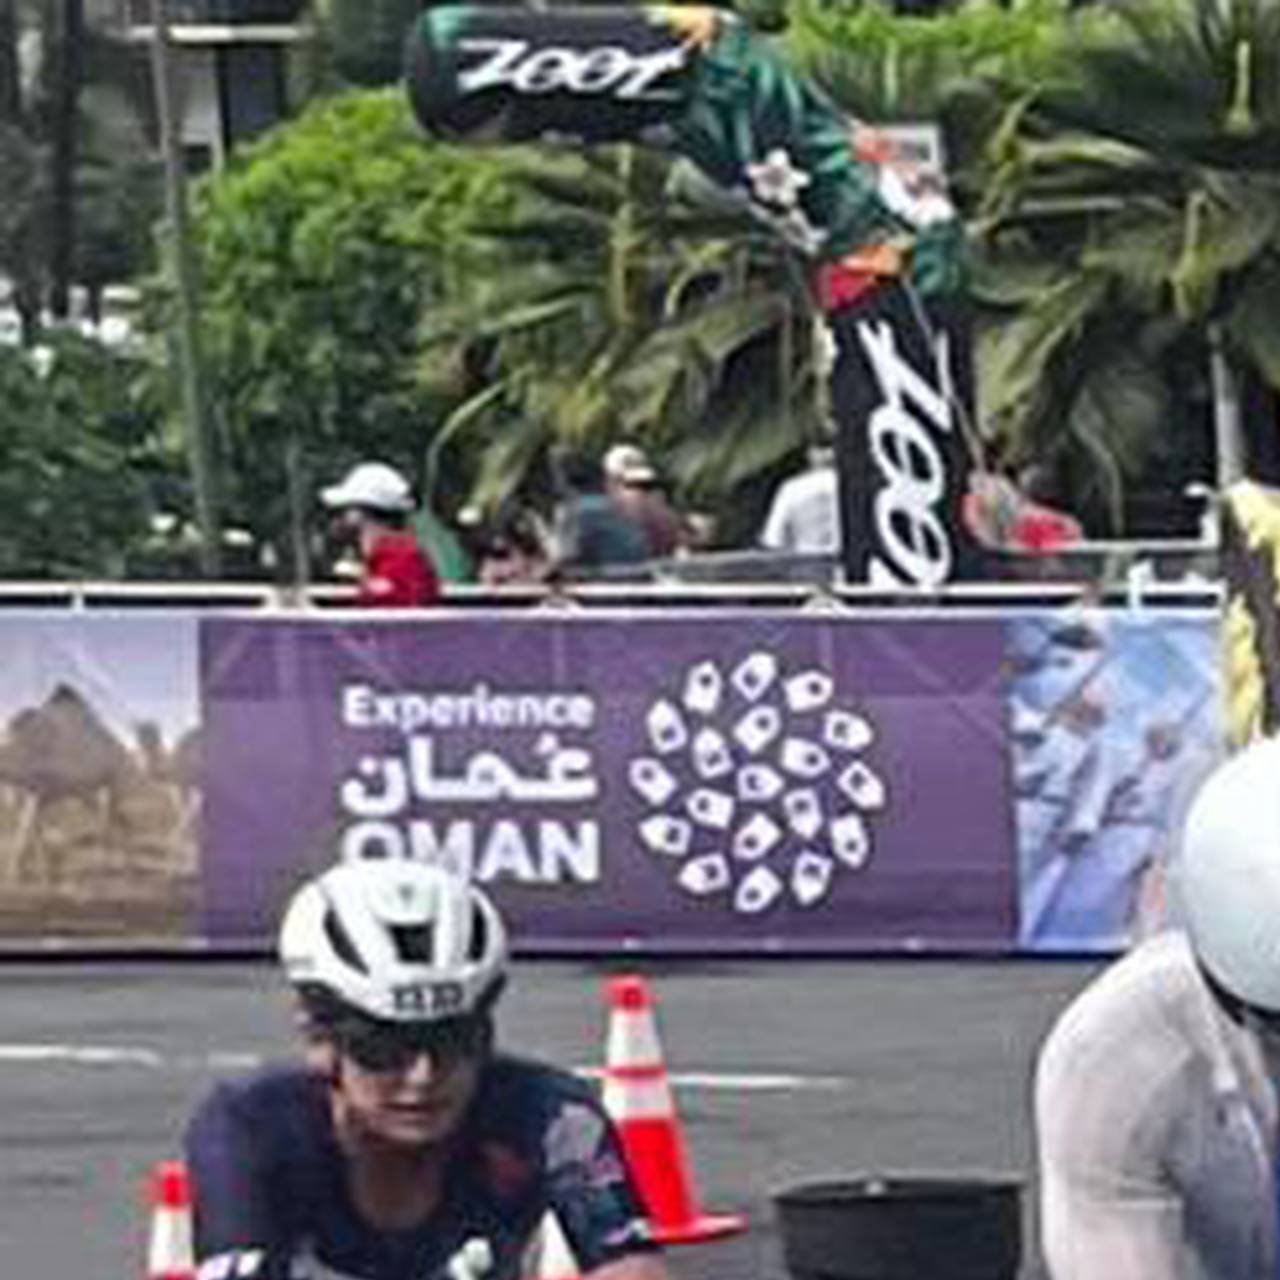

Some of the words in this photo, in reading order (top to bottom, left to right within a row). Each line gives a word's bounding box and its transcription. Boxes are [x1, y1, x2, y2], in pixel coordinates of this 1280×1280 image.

[856, 318, 951, 587] ZOO
[342, 683, 595, 732] Experience
[342, 819, 599, 883] OMAN
